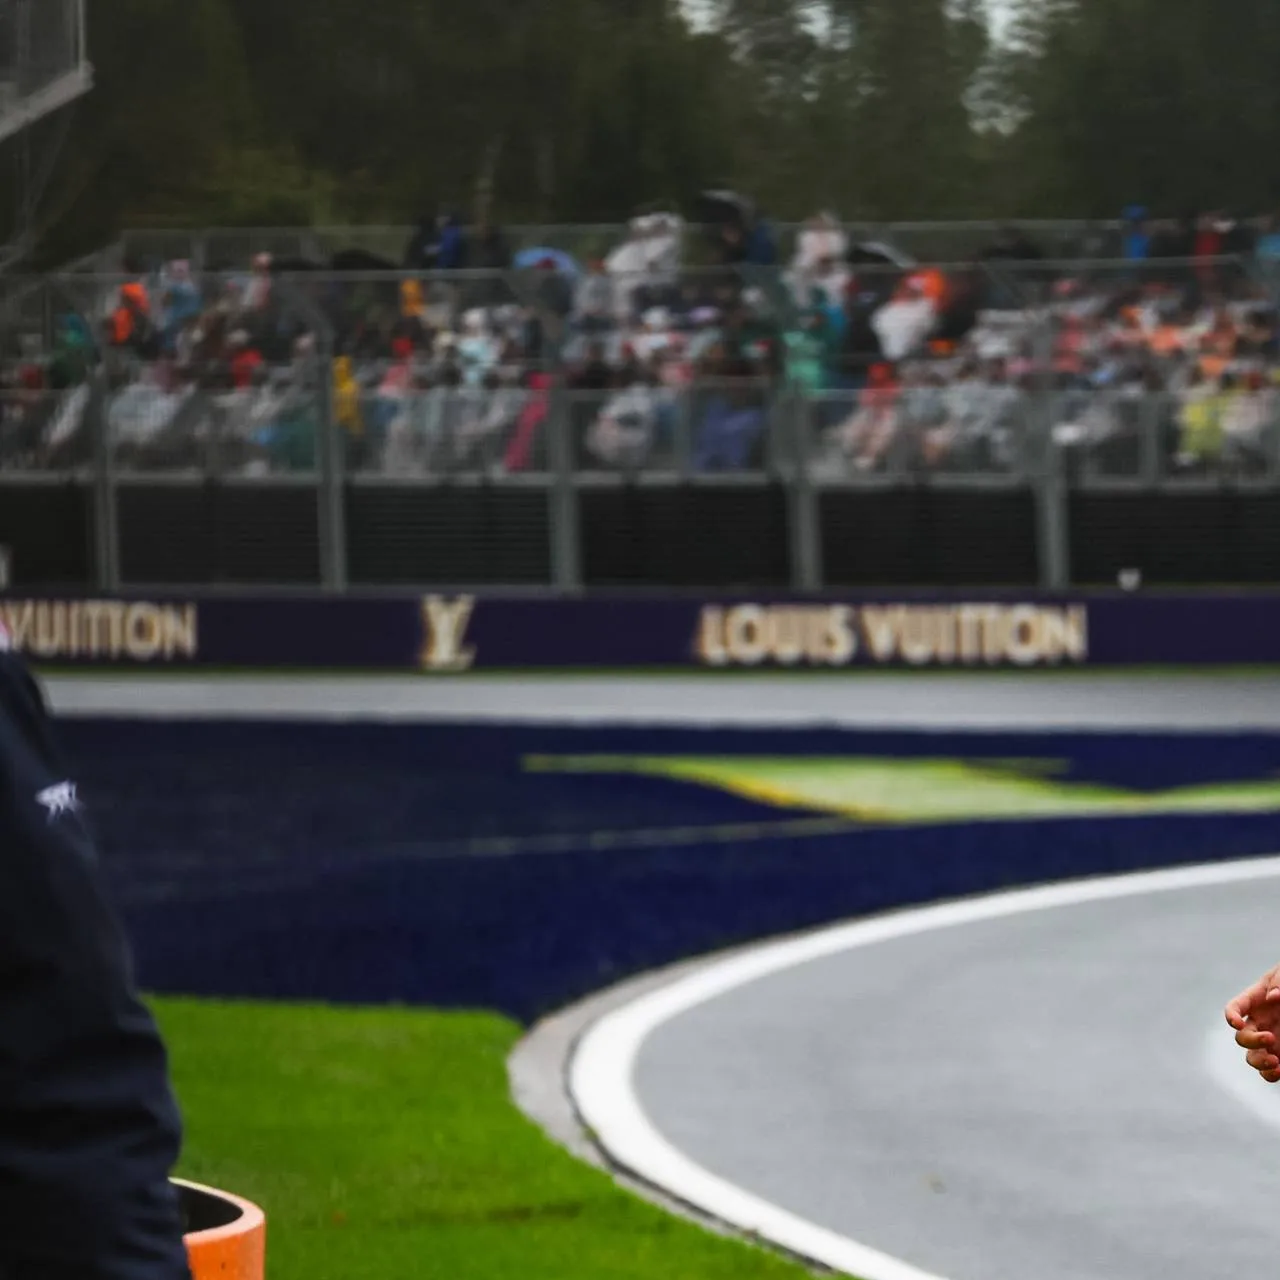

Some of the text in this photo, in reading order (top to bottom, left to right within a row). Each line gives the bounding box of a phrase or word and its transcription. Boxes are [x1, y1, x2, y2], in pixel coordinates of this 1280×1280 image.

[2, 600, 197, 660] VUITTON
[699, 602, 1087, 664] LOUIS VUITTON
